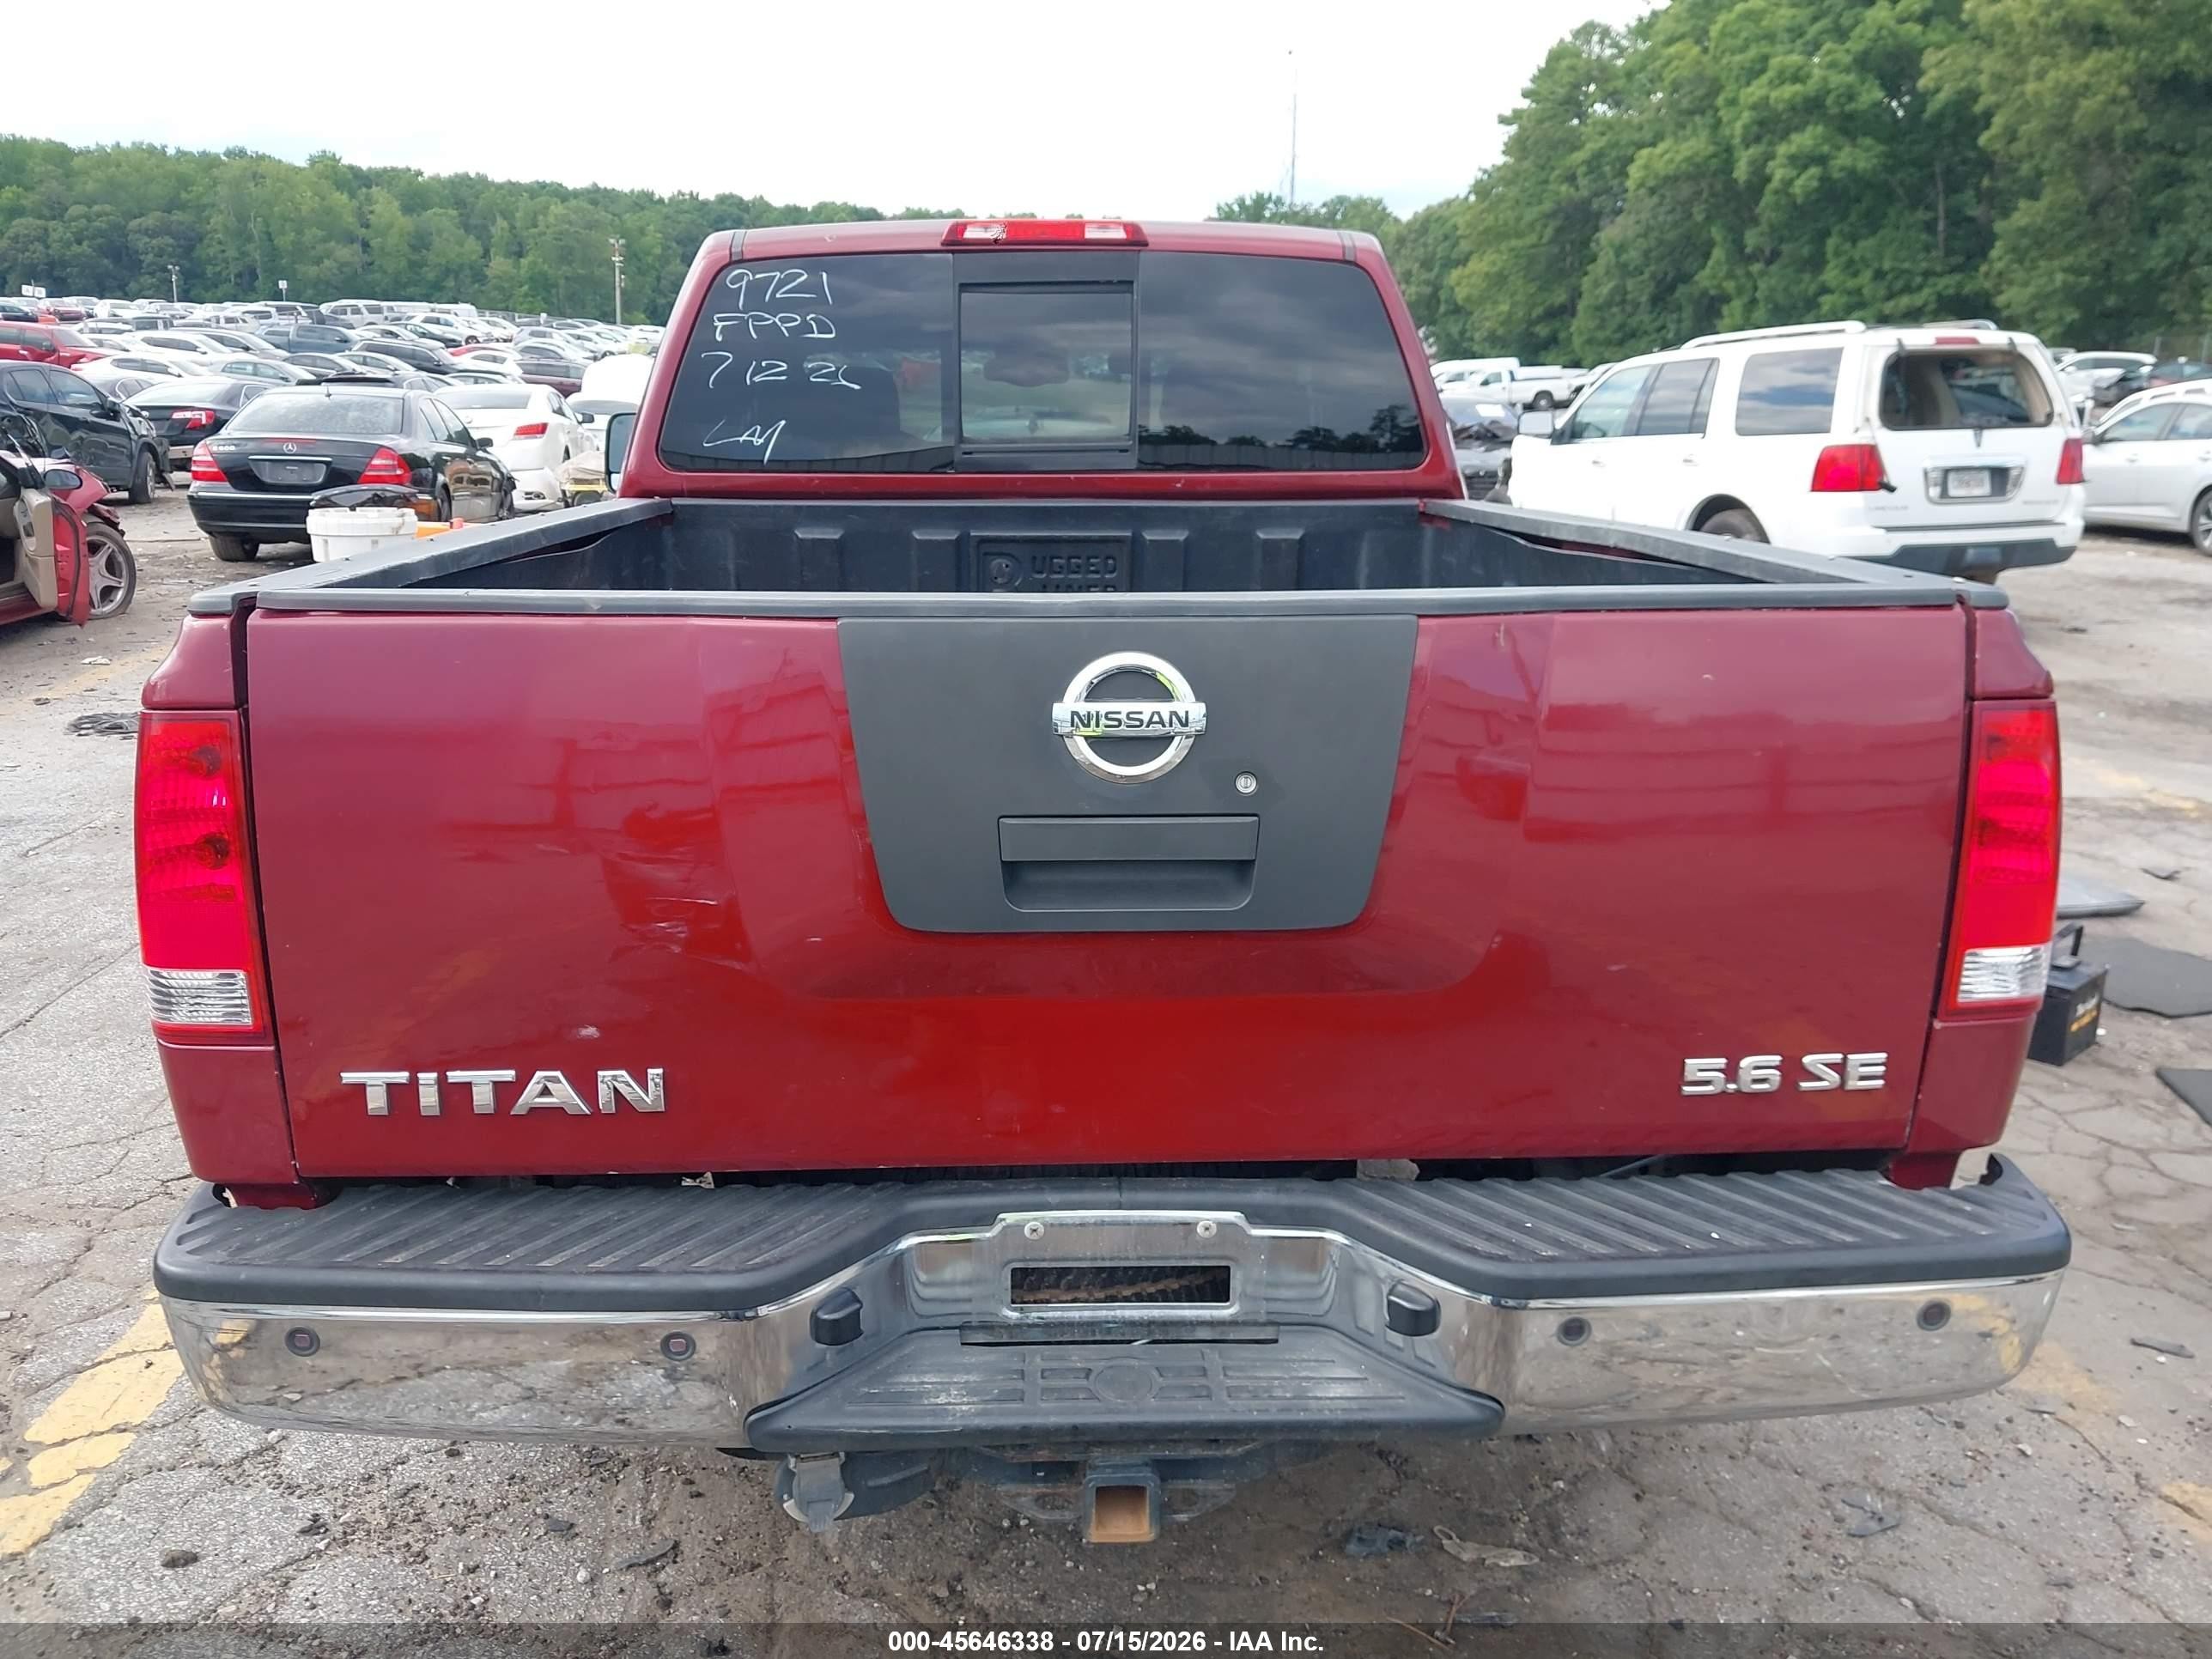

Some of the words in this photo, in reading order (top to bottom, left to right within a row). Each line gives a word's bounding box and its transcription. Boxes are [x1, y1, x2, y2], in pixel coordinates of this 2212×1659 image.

[726, 269, 832, 309] 9721
[1070, 710, 1189, 729] NISSAN
[340, 1067, 665, 1115] TITAN
[1681, 1054, 1783, 1096] 5.6
[1798, 1052, 1888, 1091] SE
